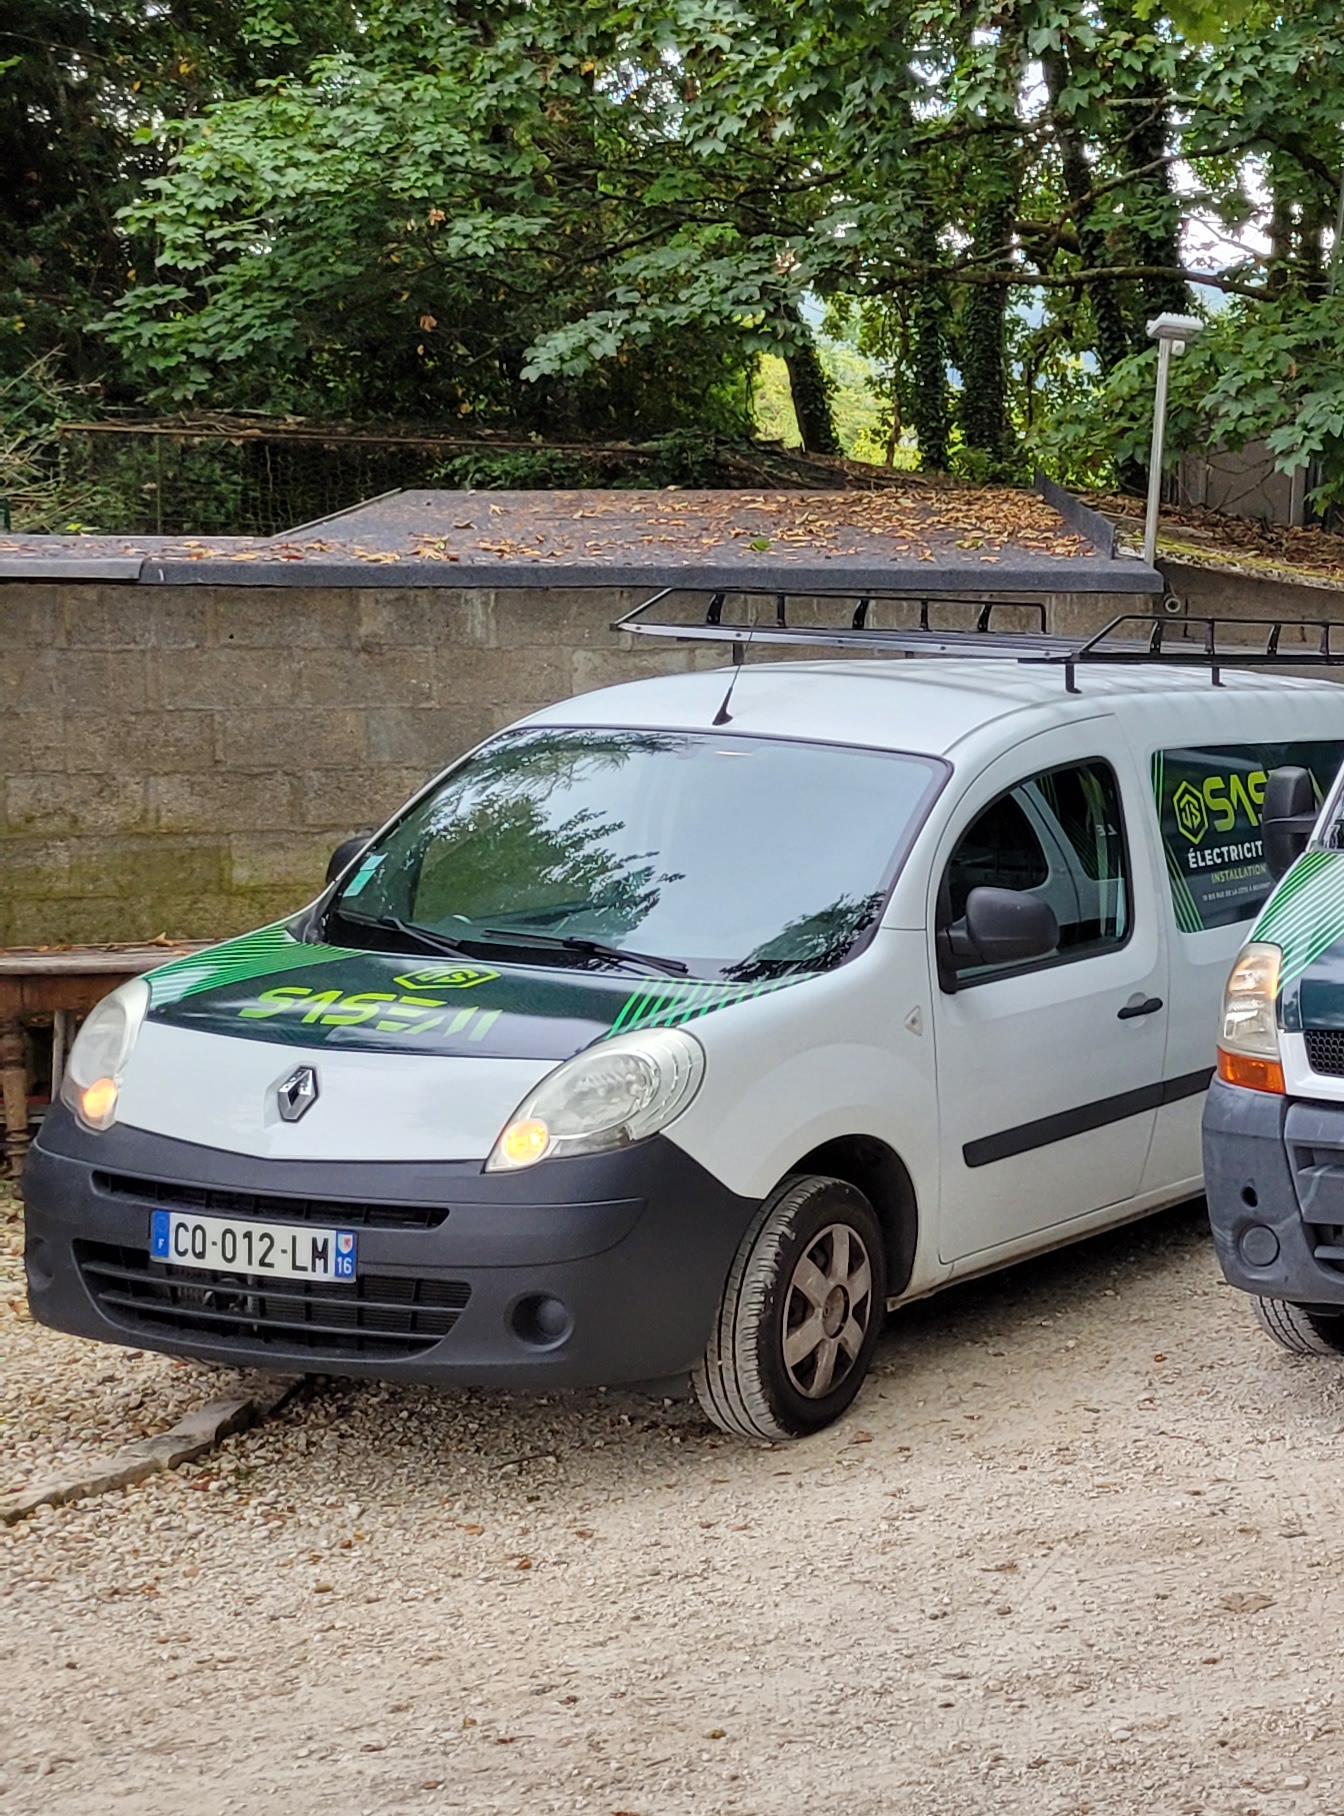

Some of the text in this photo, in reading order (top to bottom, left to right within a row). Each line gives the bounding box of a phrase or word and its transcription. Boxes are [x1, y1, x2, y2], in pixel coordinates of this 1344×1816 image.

[1187, 840, 1264, 869] ÉLECTRICIT
[1211, 863, 1267, 884] INSTALLATION
[238, 986, 503, 1041] SASEM
[158, 1221, 353, 1275] F CQ-012-LM 16
